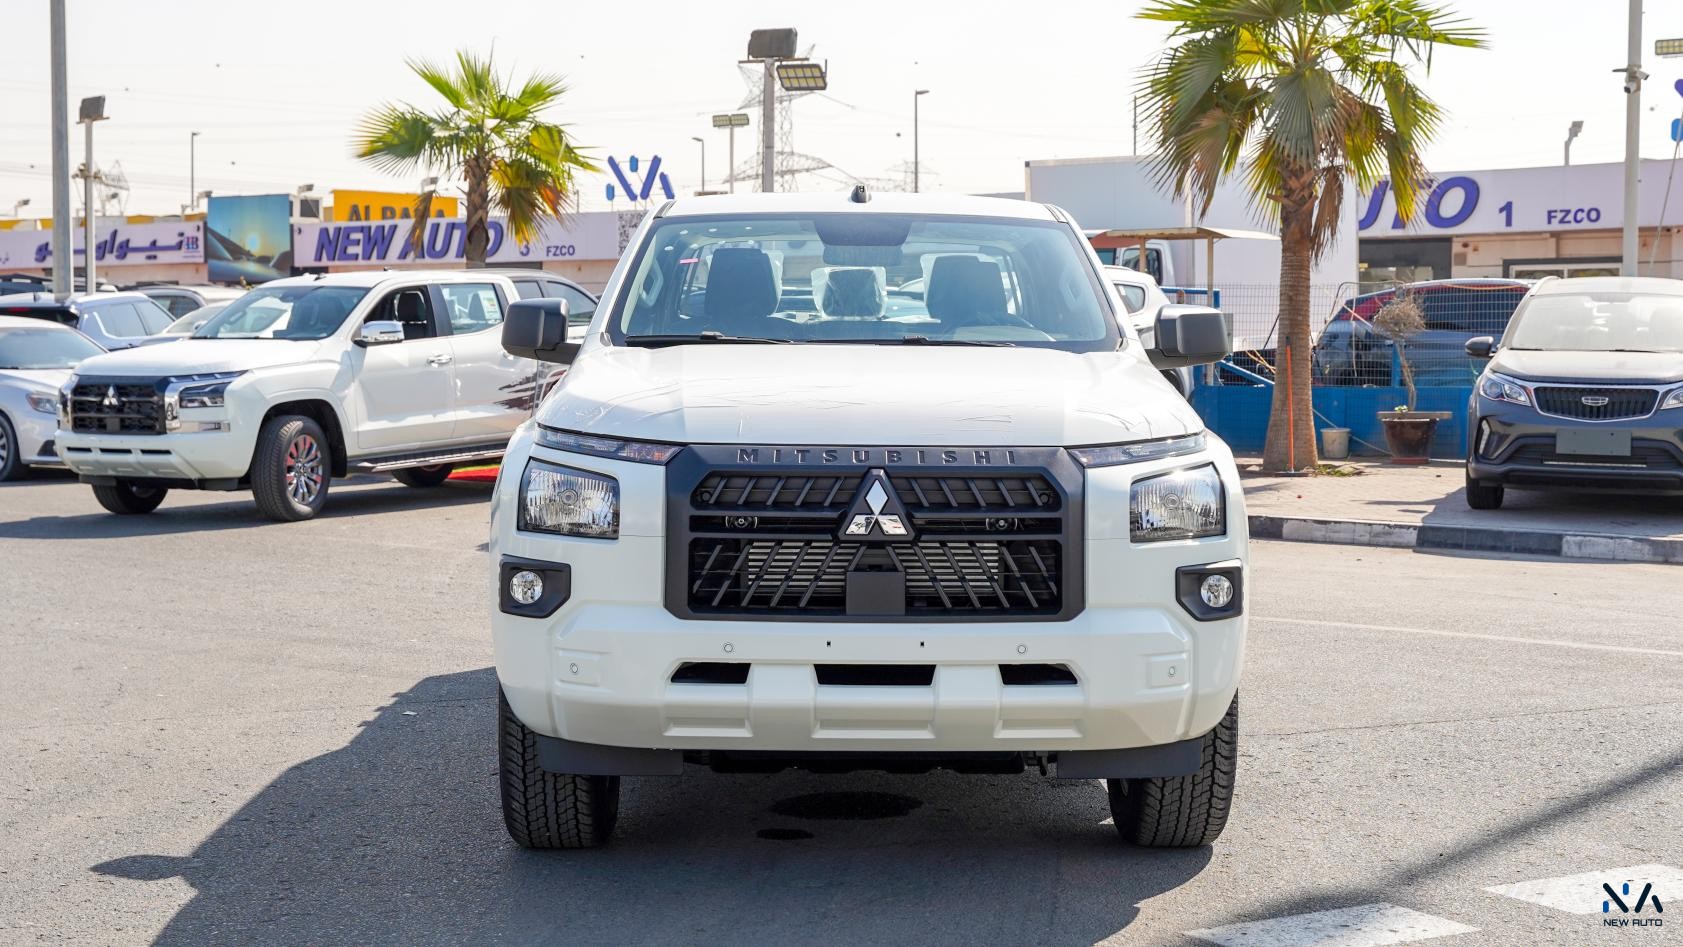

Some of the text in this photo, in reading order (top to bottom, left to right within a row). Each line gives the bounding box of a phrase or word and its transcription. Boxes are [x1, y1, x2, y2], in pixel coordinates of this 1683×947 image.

[1498, 201, 1513, 227] 1
[1547, 207, 1601, 225] FZCO
[314, 224, 398, 262] NEW
[545, 244, 576, 257] FZCO
[737, 449, 1017, 464] MITSUBISHI
